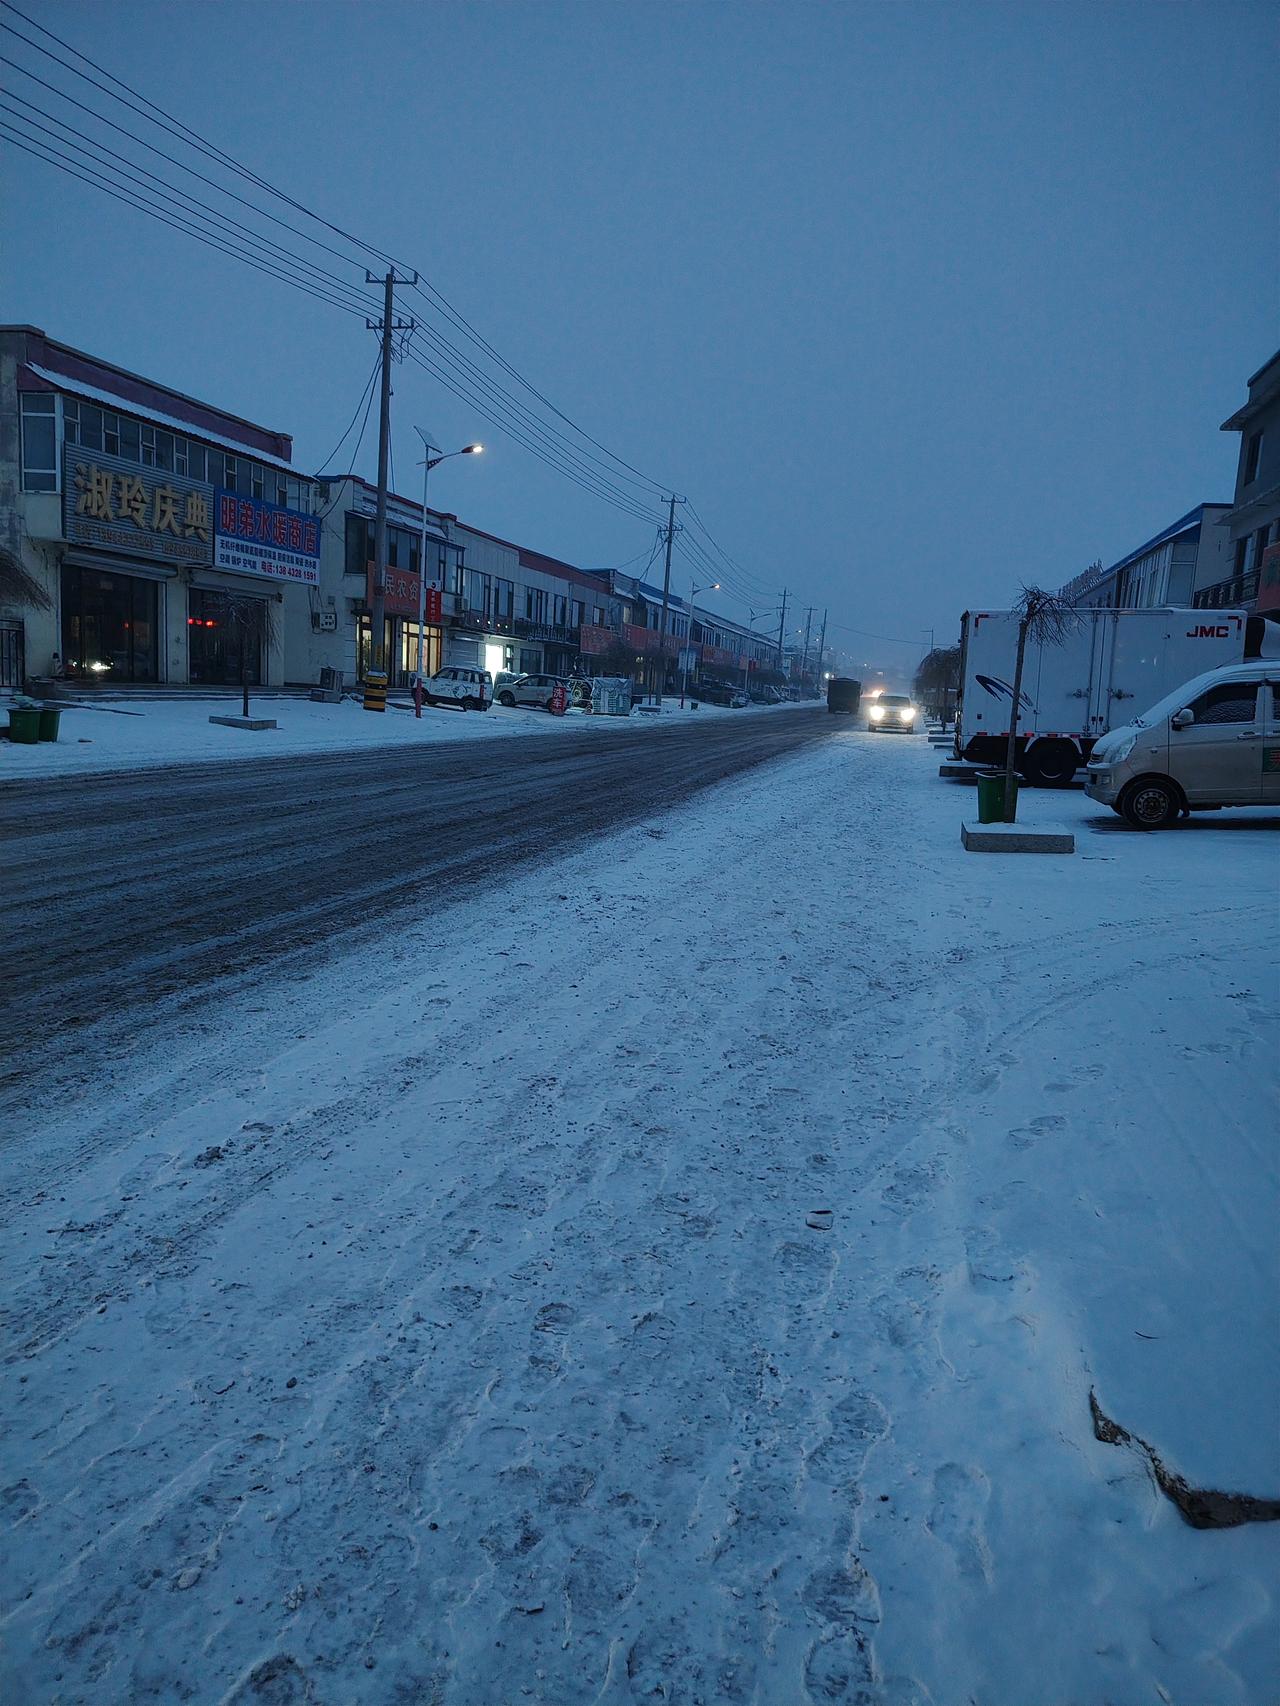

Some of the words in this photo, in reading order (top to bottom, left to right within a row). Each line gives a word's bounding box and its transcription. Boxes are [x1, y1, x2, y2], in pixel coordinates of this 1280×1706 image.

[74, 462, 209, 543] 淑玲庆典
[1186, 625, 1229, 638] JMC
[552, 687, 564, 709] 洗车
